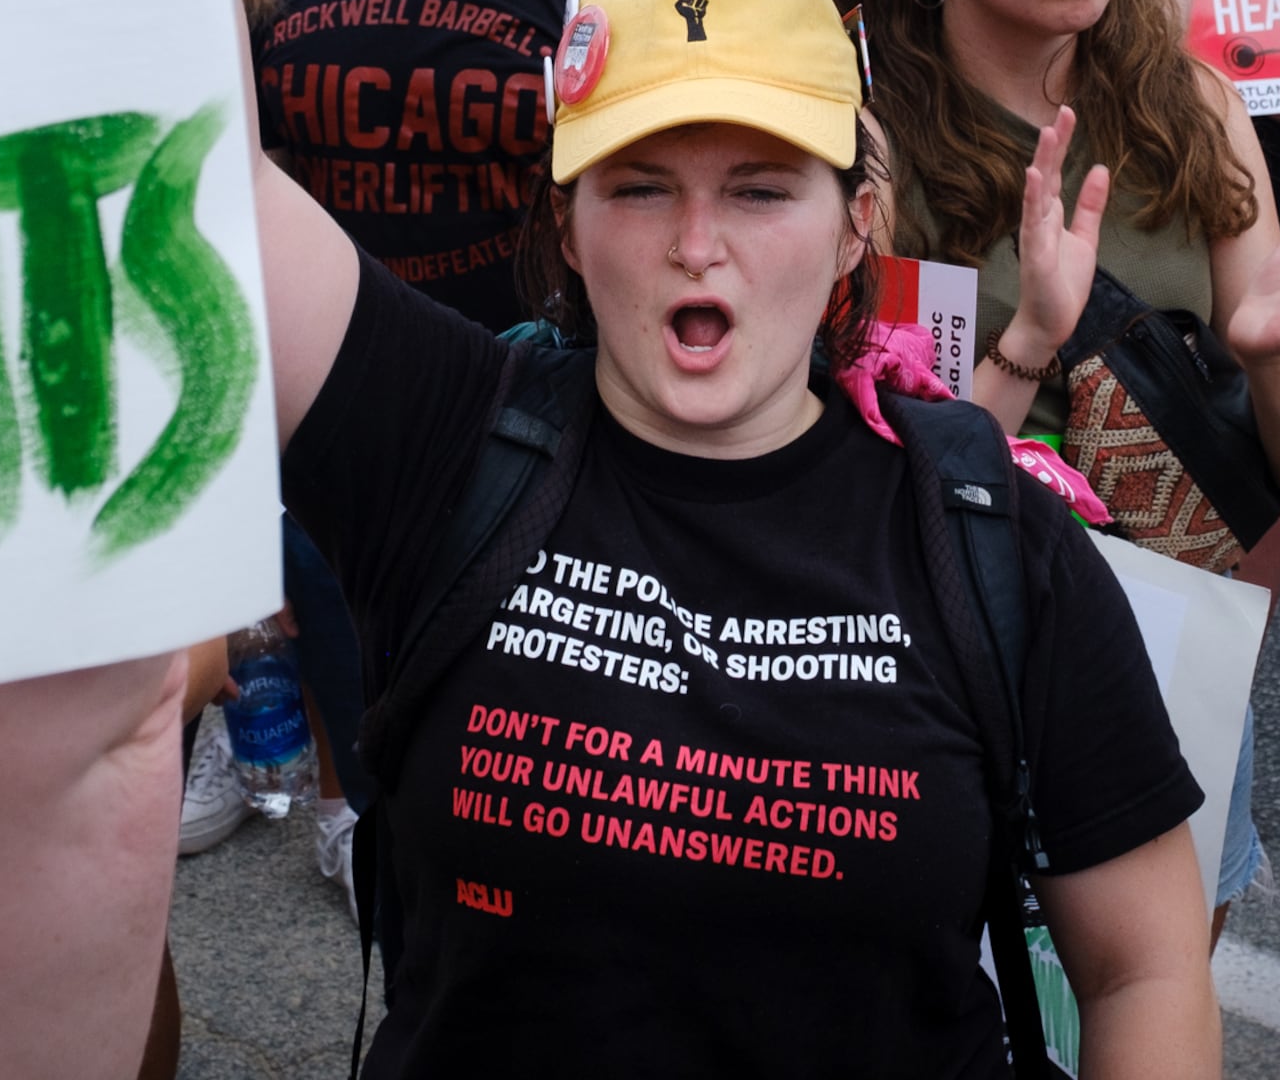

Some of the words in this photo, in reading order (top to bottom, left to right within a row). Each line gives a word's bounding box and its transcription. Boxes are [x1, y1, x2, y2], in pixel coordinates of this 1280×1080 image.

[501, 584, 672, 654] ARGETING,
[683, 632, 719, 670] OR
[726, 653, 897, 683] SHOOTING
[553, 553, 612, 595] THE
[720, 614, 911, 648] ARRESTING,
[487, 622, 689, 694] PROTESTERS:
[459, 745, 534, 786] YOUR
[542, 760, 733, 821] UNLAWFUL
[744, 797, 898, 841] ACTIONS
[467, 704, 559, 747] DON'T
[564, 722, 632, 762] FOR
[640, 740, 664, 767] A
[675, 746, 811, 789] MINUTE
[822, 762, 920, 800] THINK
[453, 787, 512, 827] WILL
[523, 802, 570, 837] GO
[580, 810, 844, 880] UNANSWERED.
[456, 878, 513, 917] ACLU
